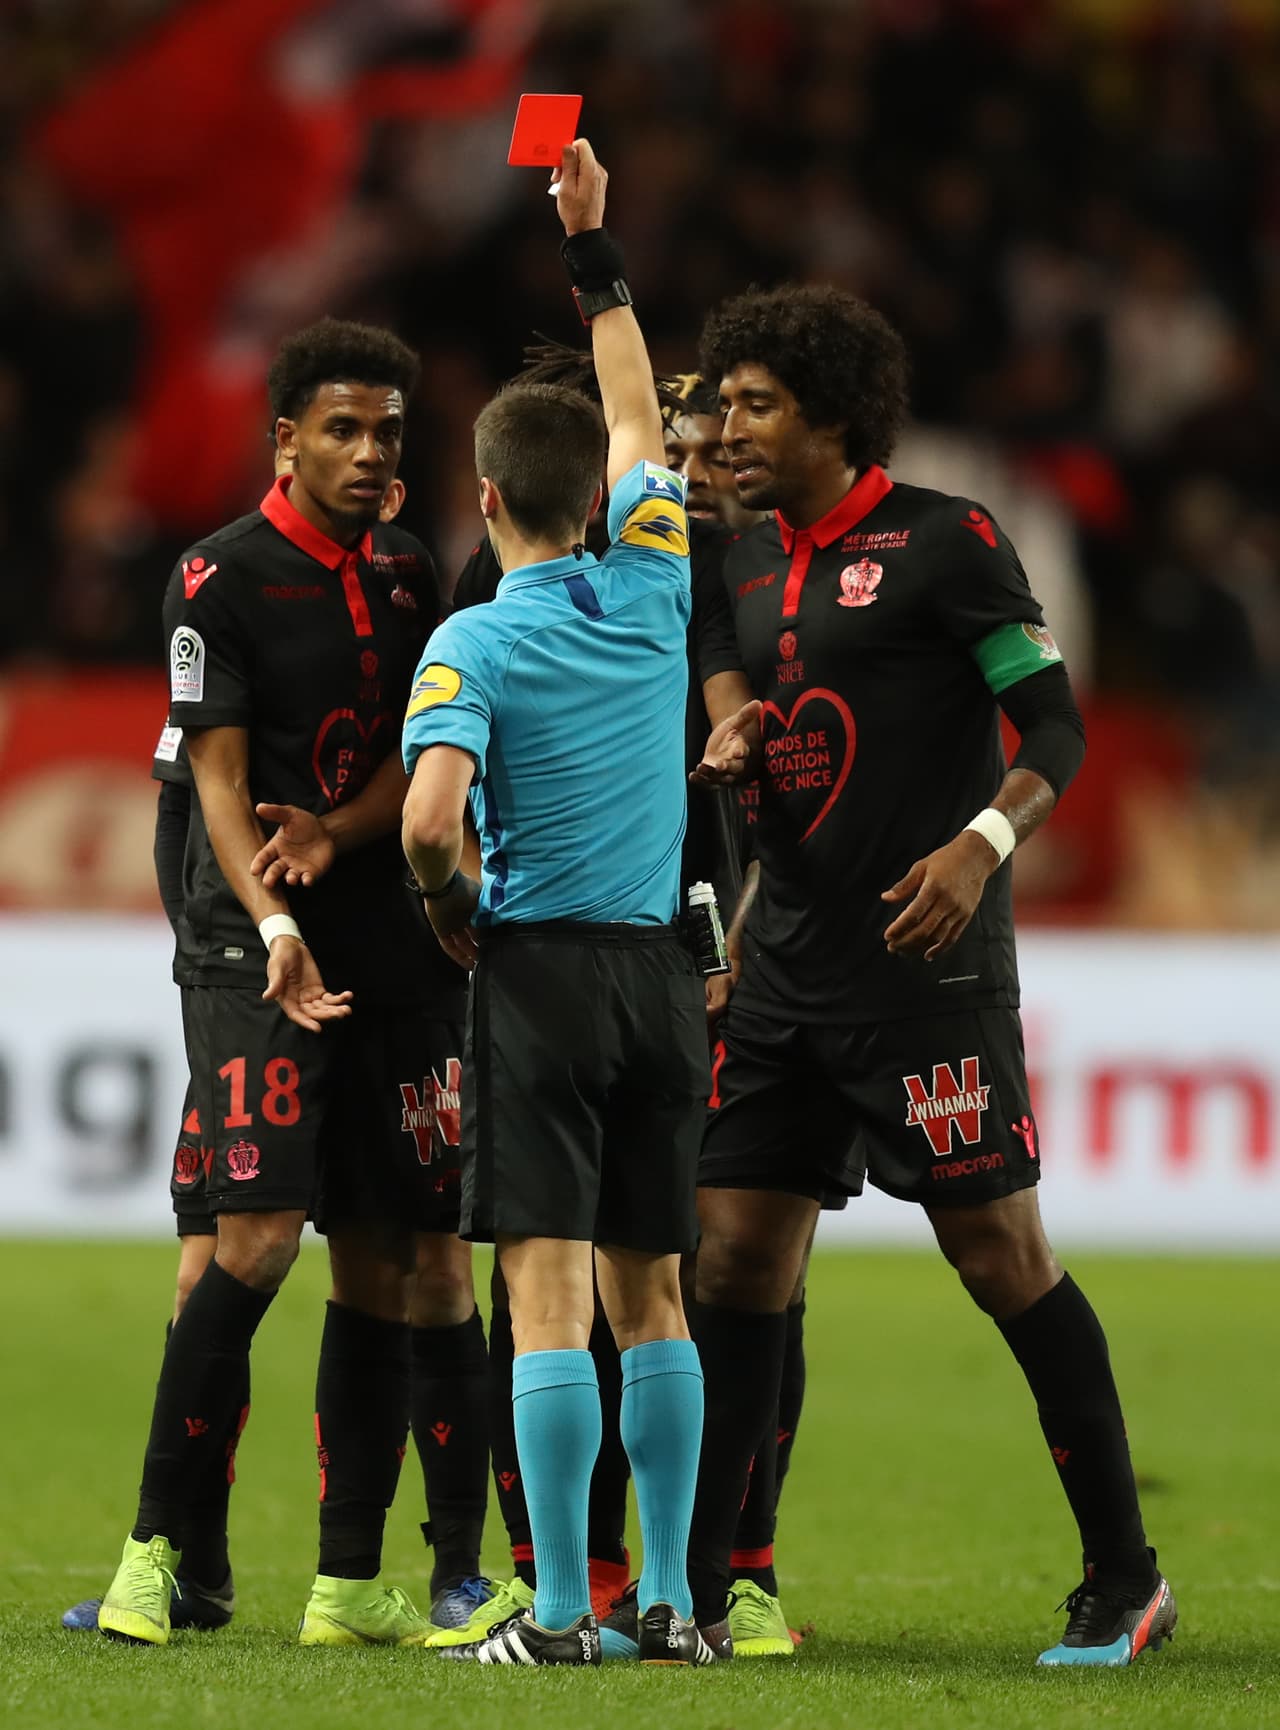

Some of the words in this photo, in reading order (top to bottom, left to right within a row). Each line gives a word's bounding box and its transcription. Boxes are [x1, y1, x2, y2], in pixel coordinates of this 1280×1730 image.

[843, 529, 912, 545] MÉTROPOLE
[777, 670, 805, 686] NICE
[807, 730, 828, 749] DE
[766, 750, 831, 776] OTATION
[795, 768, 833, 791] NICE
[217, 1056, 301, 1129] 18
[911, 1089, 986, 1121] WINAMAX
[933, 1152, 1005, 1181] macron
[578, 1630, 592, 1661] gloro
